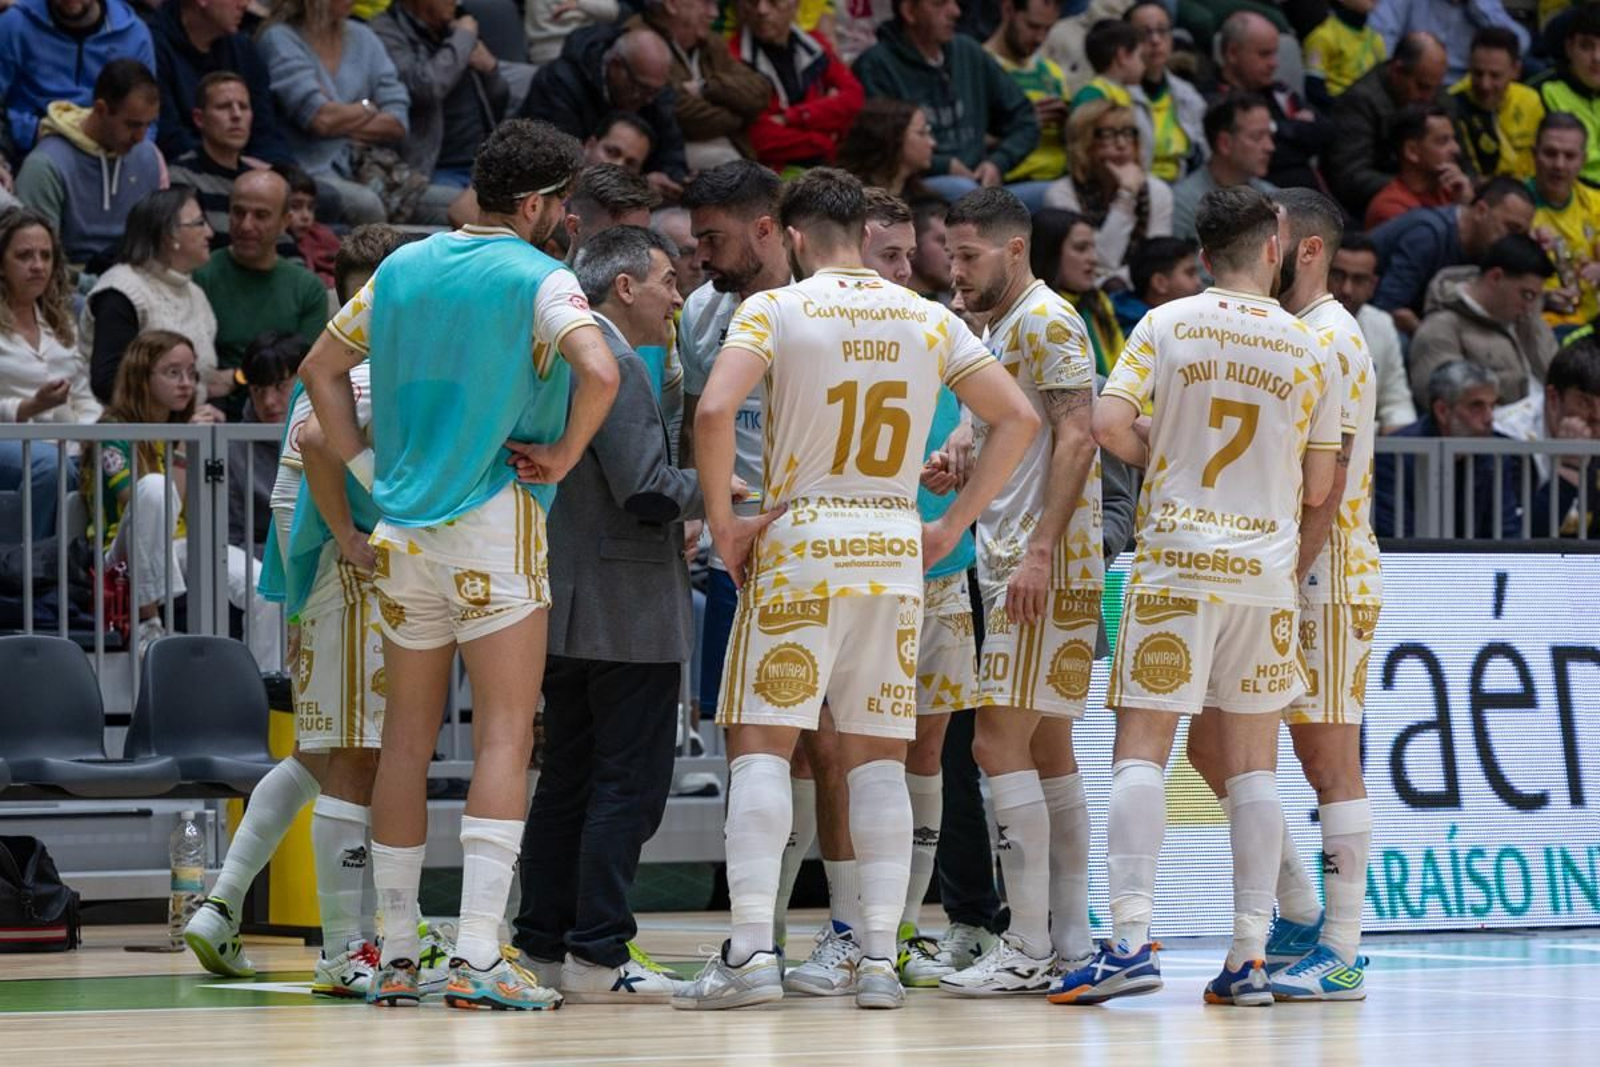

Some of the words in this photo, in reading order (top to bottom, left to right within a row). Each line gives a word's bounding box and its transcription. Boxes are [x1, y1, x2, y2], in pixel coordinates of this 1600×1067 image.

[842, 340, 900, 362] PEDRO
[1174, 322, 1308, 359] Campoameno
[1178, 360, 1218, 387] JAVI
[1225, 361, 1293, 401] ALONSO
[827, 380, 911, 477] 16
[1201, 397, 1260, 489] 7
[980, 652, 1010, 681] 30
[1241, 678, 1261, 693] EL
[867, 696, 884, 714] EL
